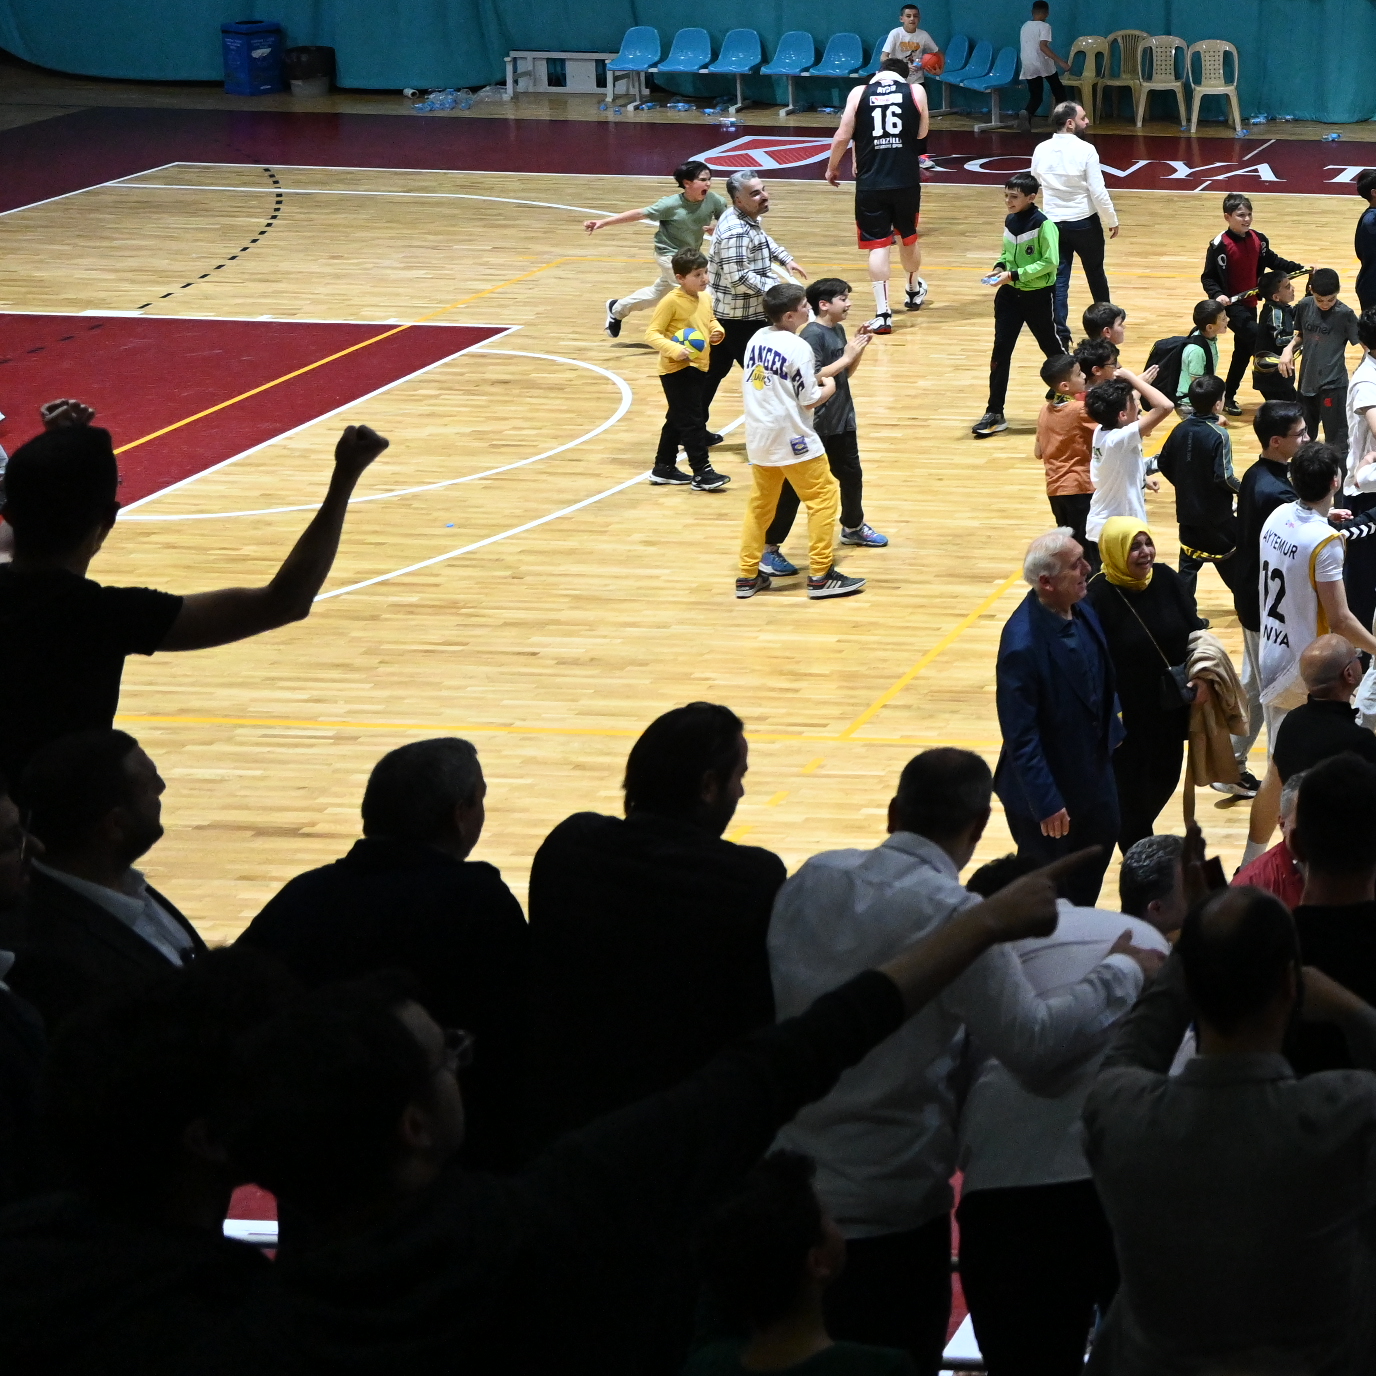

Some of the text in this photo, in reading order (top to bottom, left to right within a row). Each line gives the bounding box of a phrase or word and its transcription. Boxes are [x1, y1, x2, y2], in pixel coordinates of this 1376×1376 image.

[871, 105, 903, 137] 16
[1263, 528, 1298, 560] AYTEMUR
[1262, 559, 1286, 624] 12
